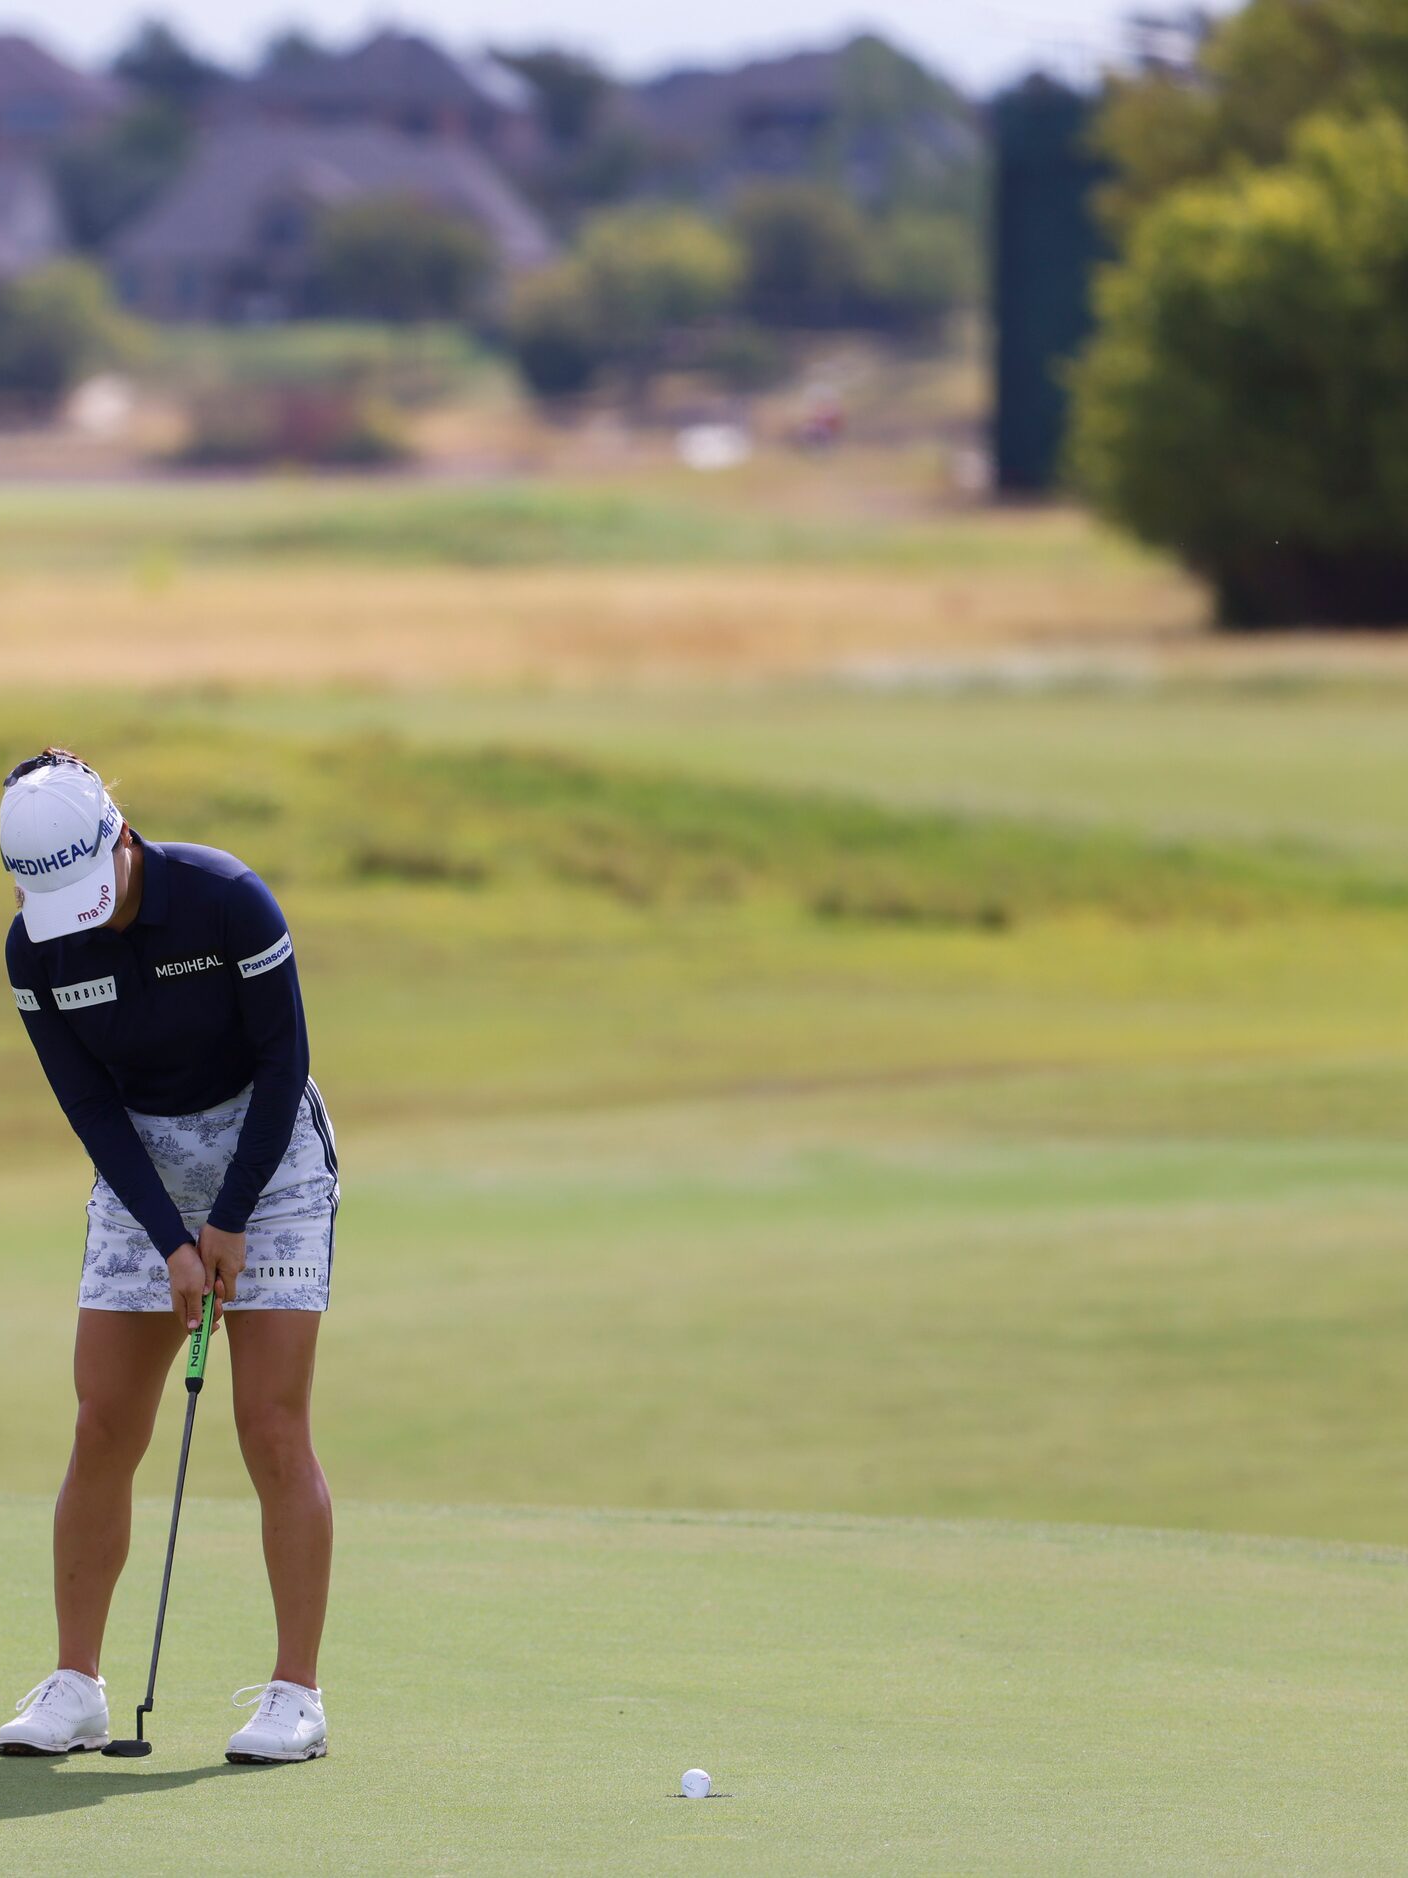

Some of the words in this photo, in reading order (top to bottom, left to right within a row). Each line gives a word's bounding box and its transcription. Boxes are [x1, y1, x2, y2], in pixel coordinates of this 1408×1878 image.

[6, 838, 94, 876] MEDIHEAL
[77, 884, 111, 922] ma:nyo
[155, 955, 223, 978] MEDIHEAL
[242, 941, 291, 972] Panasonic
[56, 983, 113, 1003] TORBIST
[259, 1266, 317, 1278] TORBIST
